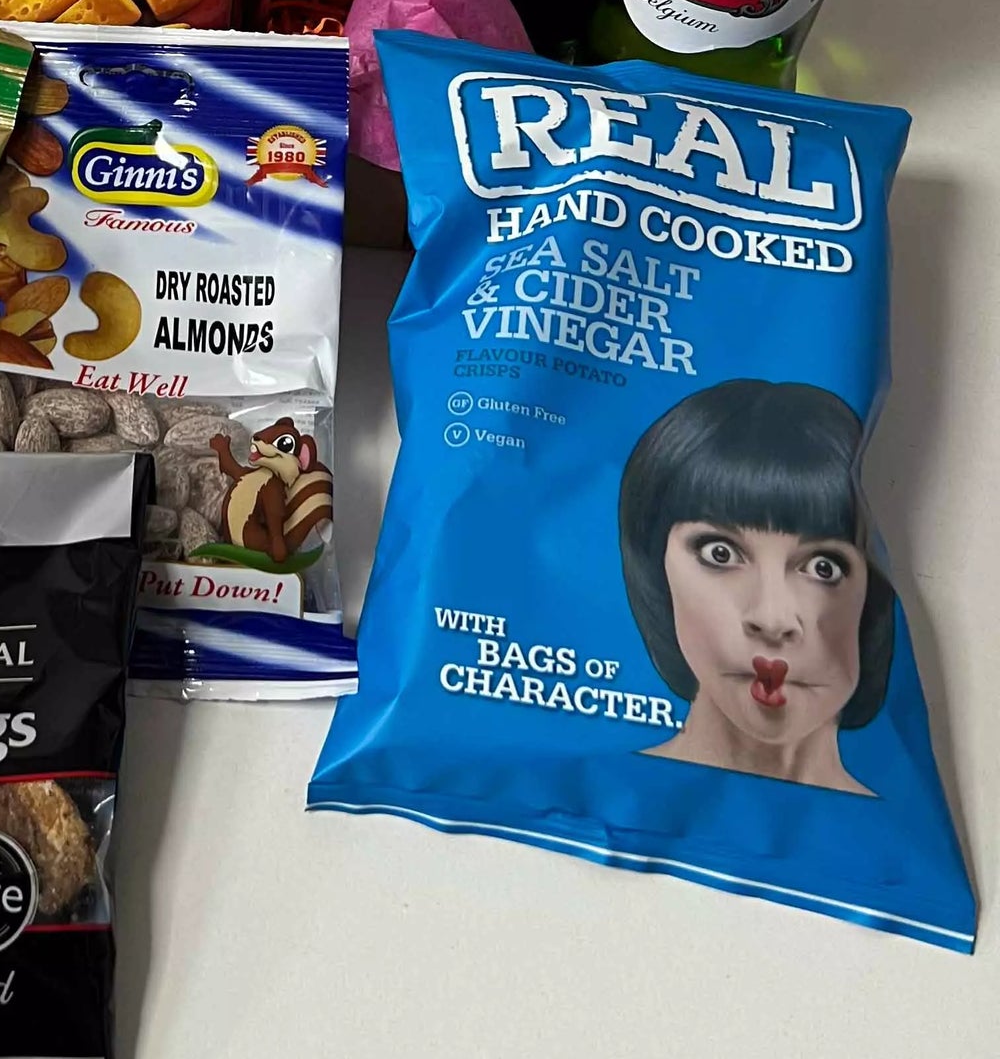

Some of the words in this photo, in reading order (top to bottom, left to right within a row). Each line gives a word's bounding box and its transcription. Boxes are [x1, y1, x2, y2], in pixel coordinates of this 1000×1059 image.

[268, 151, 306, 162] 1980
[480, 83, 836, 211] REAL
[84, 209, 197, 234] Famous
[486, 189, 627, 243] HAND
[639, 204, 854, 275] COOKED
[482, 235, 567, 282] SEA
[581, 238, 701, 302] SALT
[155, 270, 191, 302] DRY
[196, 272, 275, 307] ROASTED
[466, 277, 500, 307] &
[515, 267, 673, 334] CIDER
[154, 316, 274, 357] ALMONDS
[461, 305, 698, 377] VINEGAR
[74, 364, 122, 393] Eat
[127, 371, 190, 399] Well
[453, 363, 521, 379] CRISPS
[455, 348, 549, 369] FLAVOUR
[552, 356, 628, 387] POTATO
[451, 398, 470, 409] GF
[477, 396, 531, 418] Gluten
[534, 405, 567, 426] Free
[474, 428, 526, 449] Vegan
[140, 570, 183, 598] Put
[191, 574, 284, 604] Down!
[434, 607, 507, 638] WITH
[477, 638, 578, 677] BAGS
[585, 658, 621, 681] OF
[439, 663, 685, 730] CHARACTER.
